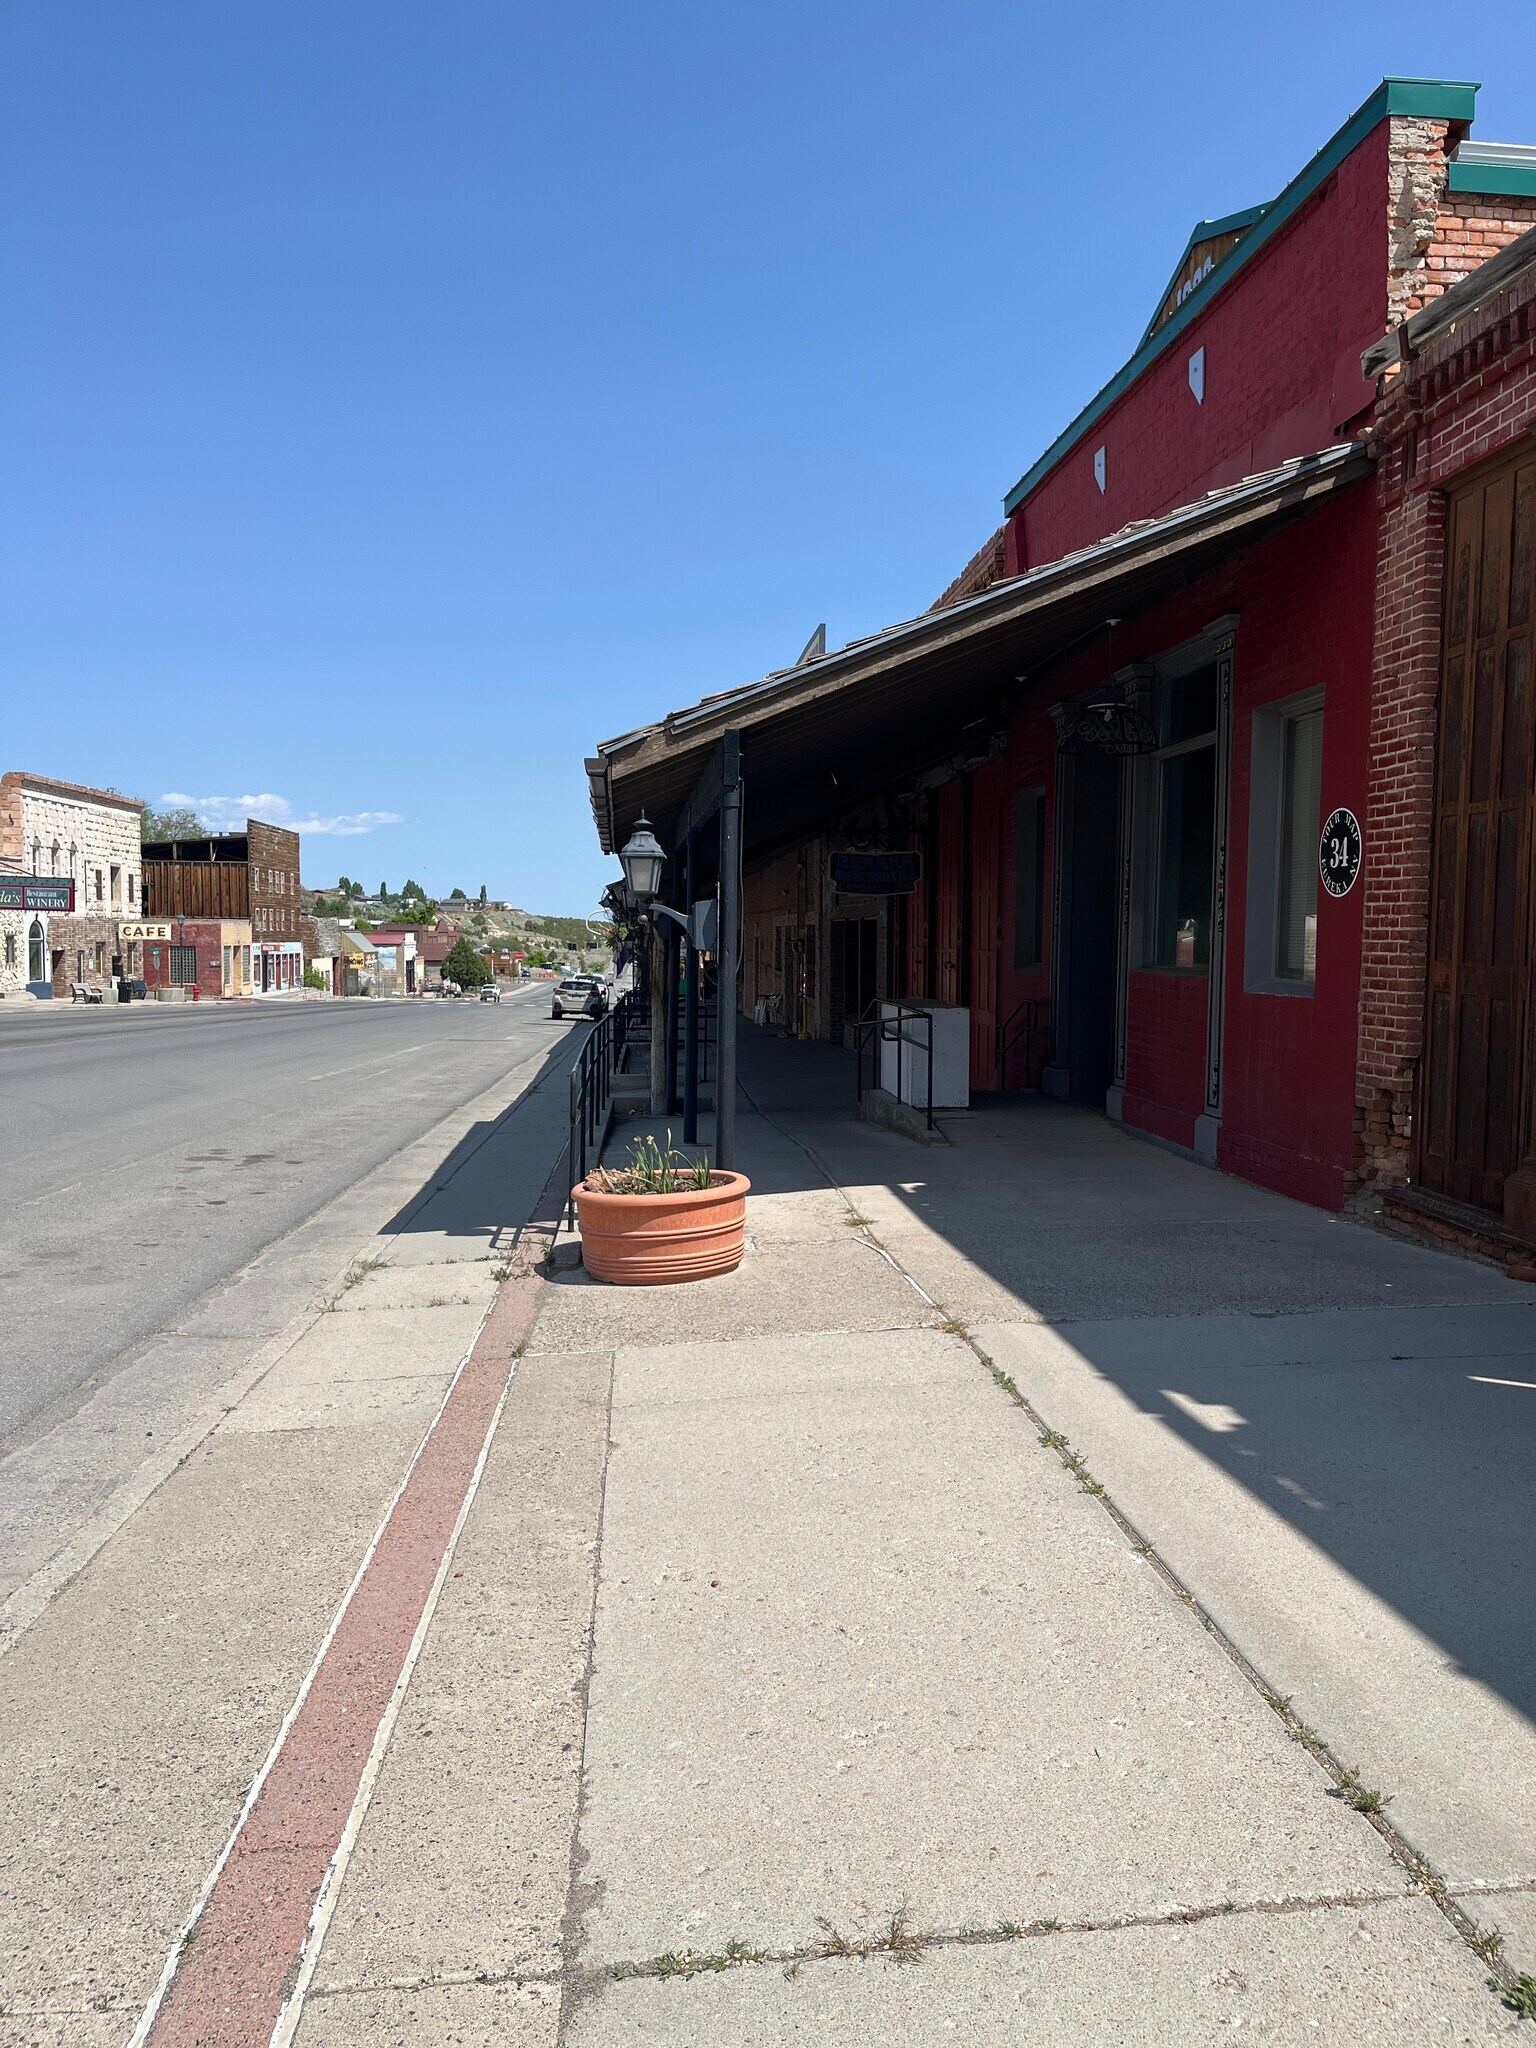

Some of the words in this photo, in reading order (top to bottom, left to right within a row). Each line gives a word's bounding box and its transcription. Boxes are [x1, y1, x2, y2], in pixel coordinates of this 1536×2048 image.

[1322, 812, 1341, 844] TOUR
[1343, 812, 1359, 842] MAP
[1329, 836, 1349, 868] 34
[1321, 858, 1348, 894] EUREKA
[26, 889, 58, 897] Restaurant
[26, 897, 67, 908] WINERY
[122, 926, 166, 937] CAFE
